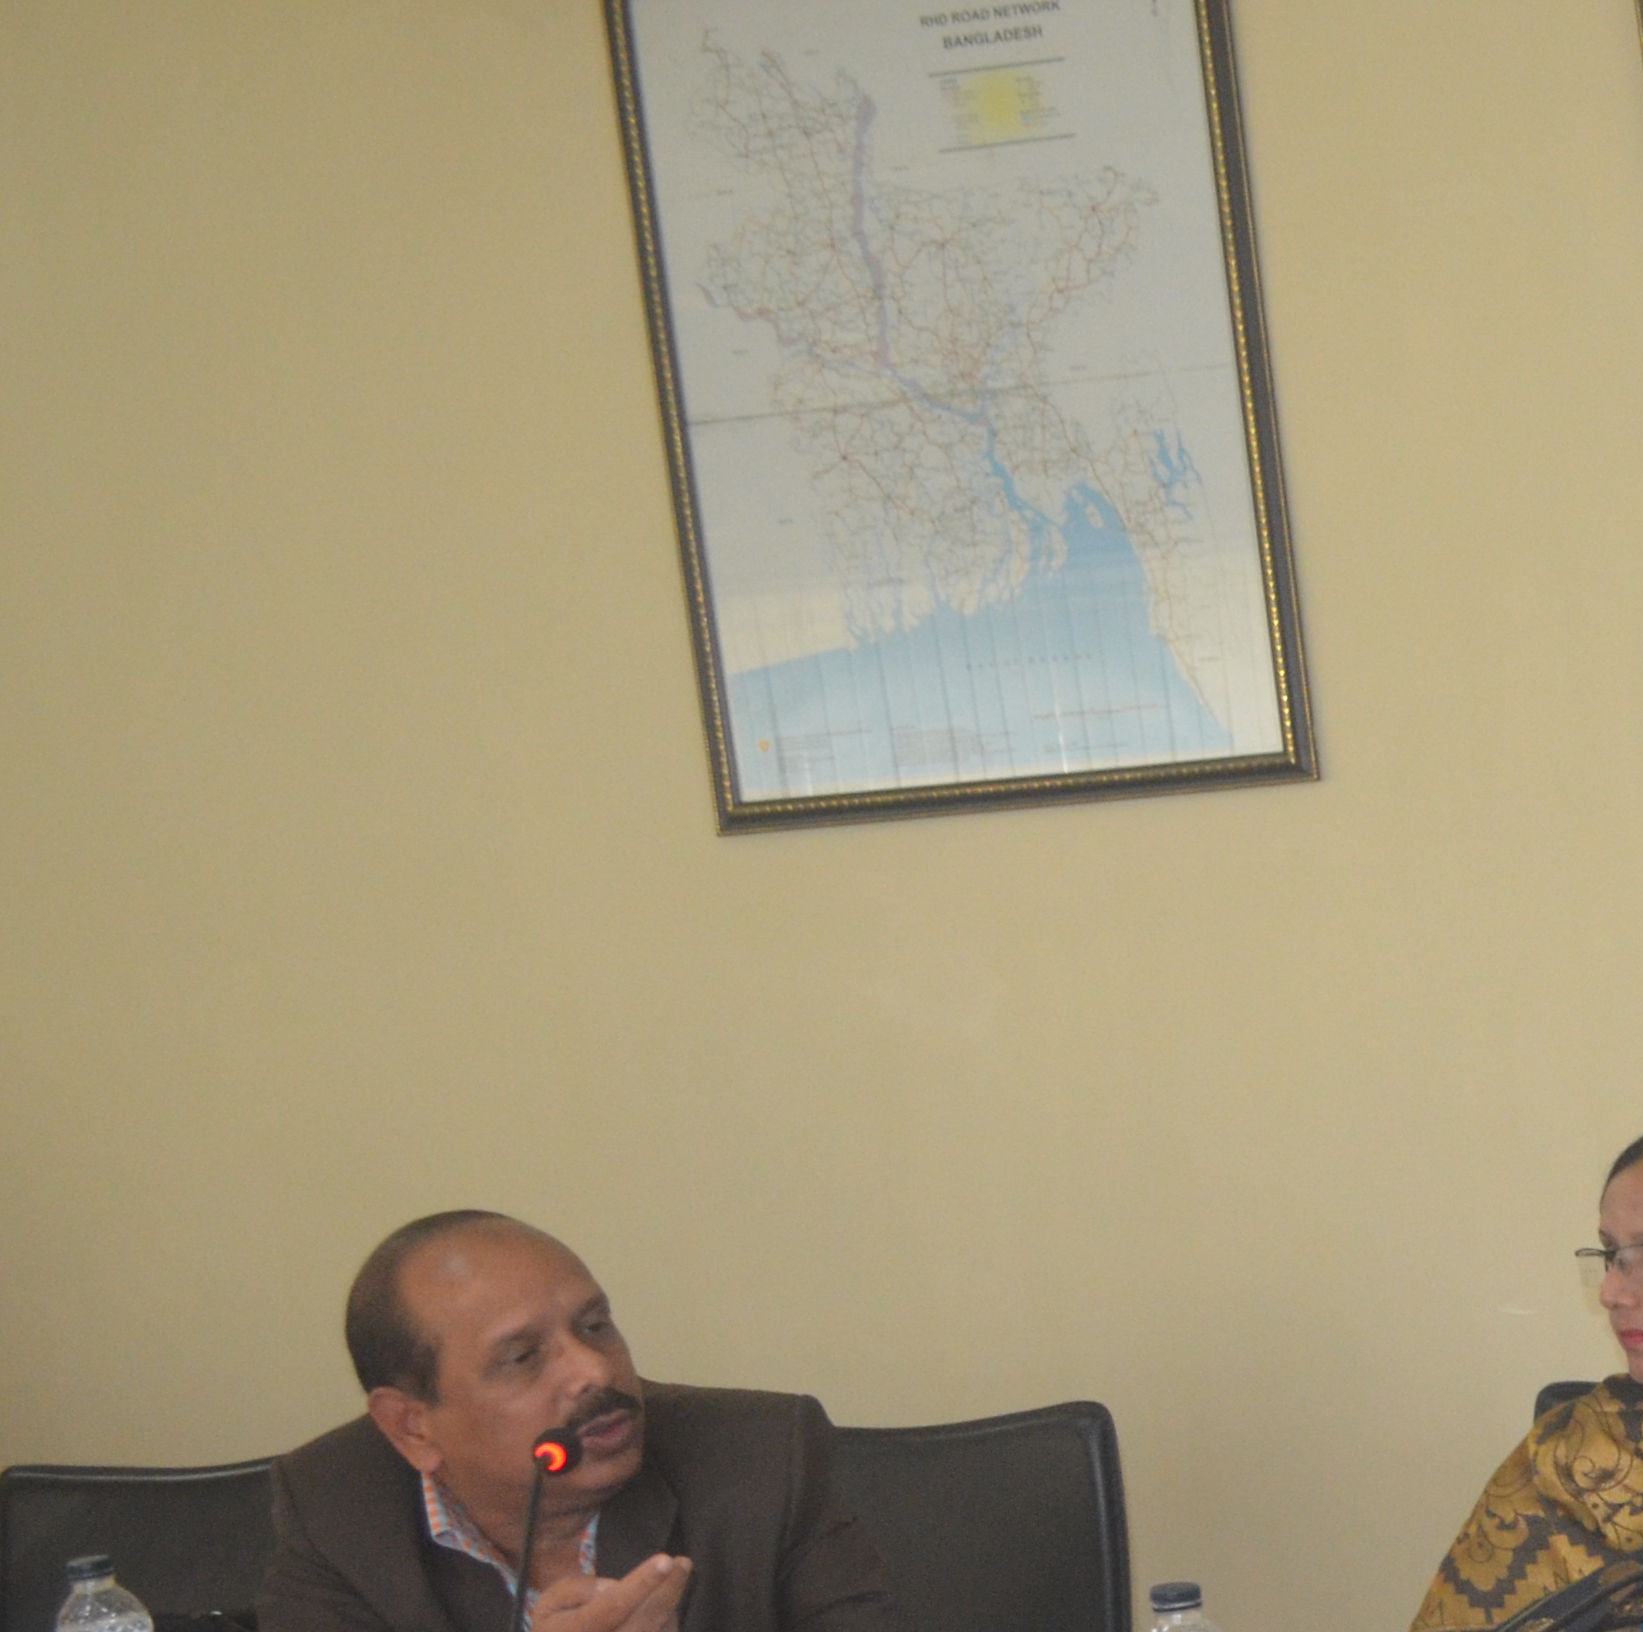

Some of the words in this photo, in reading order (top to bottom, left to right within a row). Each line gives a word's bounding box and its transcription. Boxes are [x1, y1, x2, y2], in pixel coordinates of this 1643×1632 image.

[951, 9, 990, 25] ROAD
[993, 1, 1061, 18] NETWORK
[943, 24, 1044, 49] BANGLADESH
